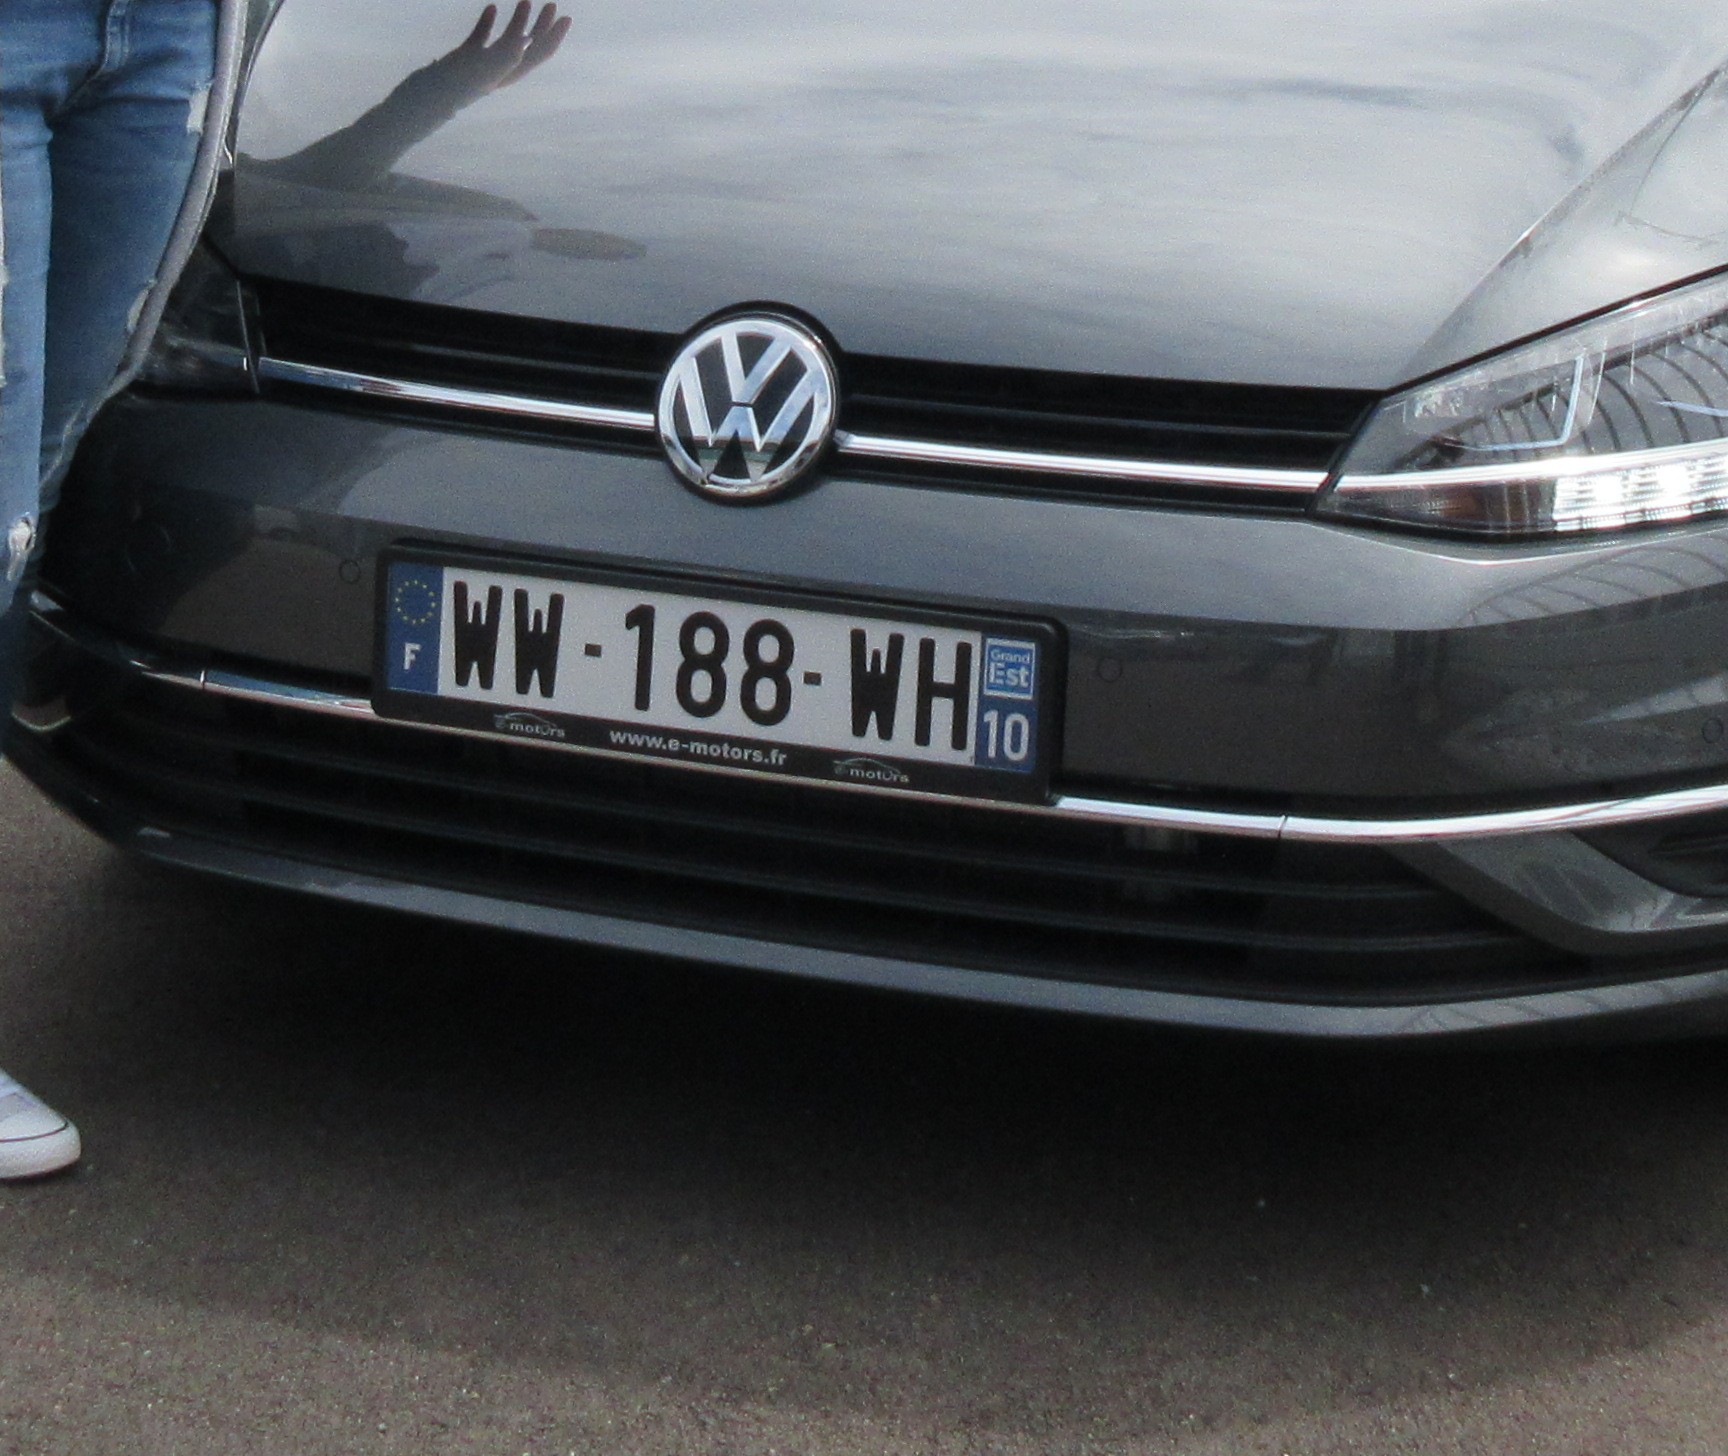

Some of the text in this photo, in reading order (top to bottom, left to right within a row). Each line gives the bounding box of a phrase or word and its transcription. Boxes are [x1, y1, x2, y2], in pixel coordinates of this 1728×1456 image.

[403, 643, 421, 670] F
[990, 648, 1030, 664] Grand
[989, 662, 1030, 689] Est
[609, 729, 788, 767] www.e-motors.fr
[983, 709, 1030, 761] 10
